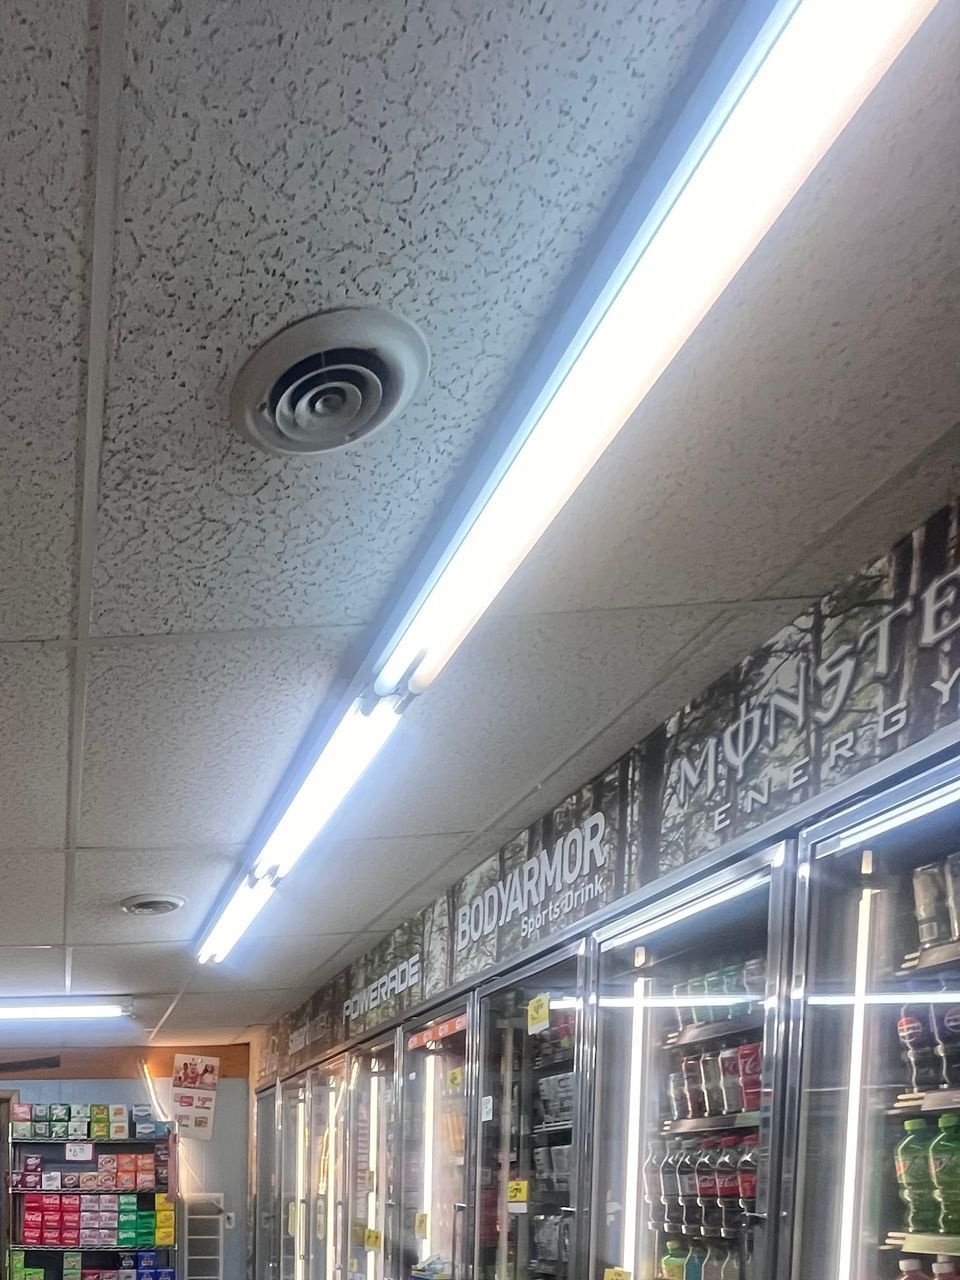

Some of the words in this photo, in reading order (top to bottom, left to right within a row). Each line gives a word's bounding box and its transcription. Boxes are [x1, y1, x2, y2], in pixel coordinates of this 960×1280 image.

[457, 811, 606, 952] BODYARMOR
[521, 900, 562, 939] Sports
[562, 874, 604, 914] Drink
[343, 953, 420, 1025] POWERADE
